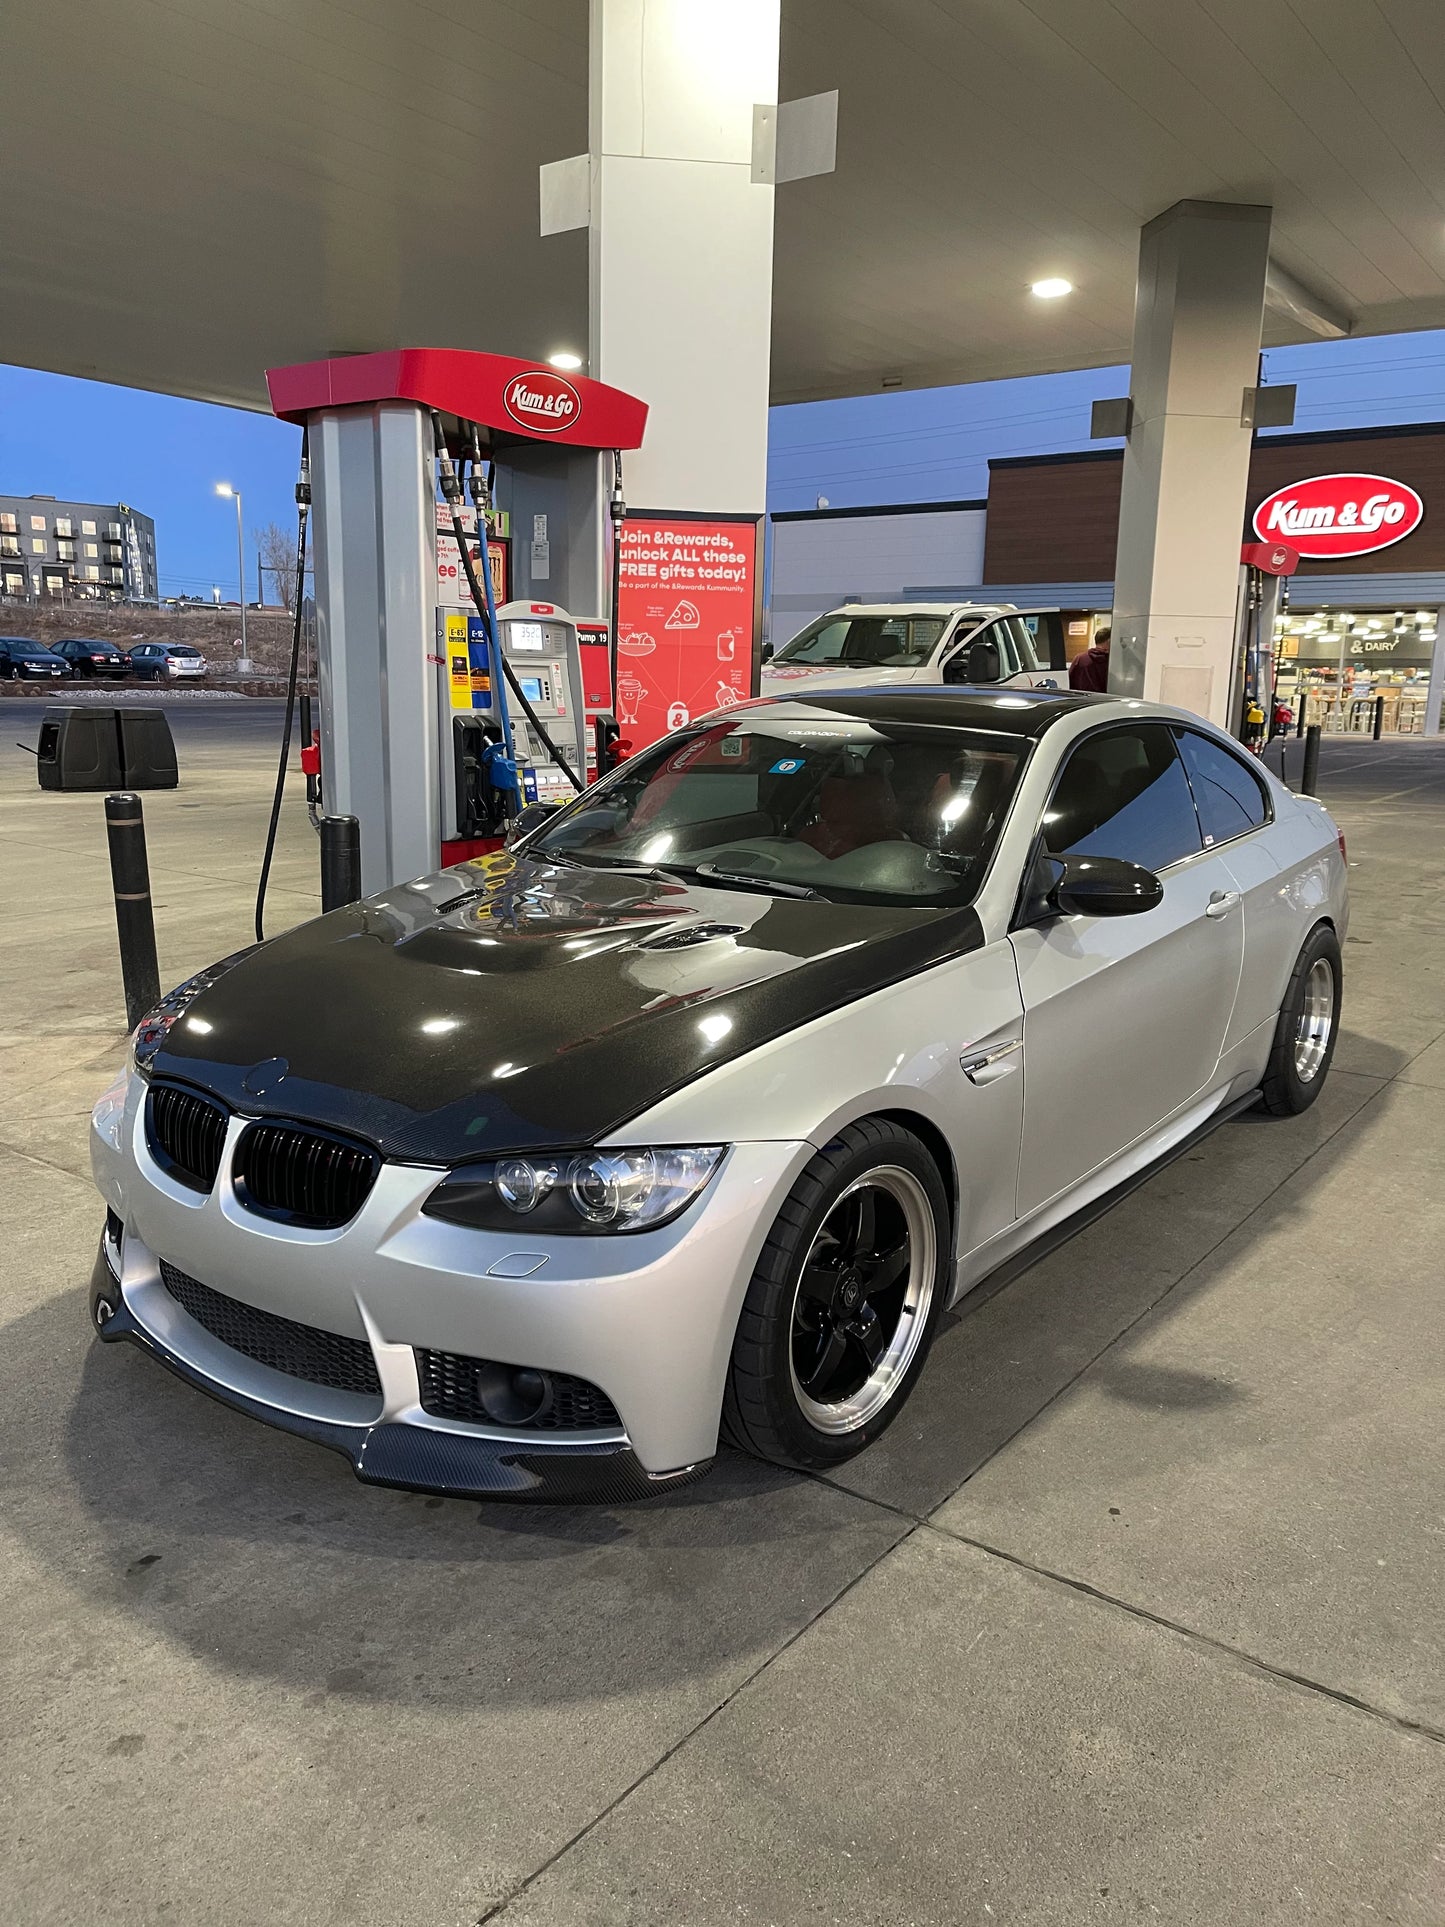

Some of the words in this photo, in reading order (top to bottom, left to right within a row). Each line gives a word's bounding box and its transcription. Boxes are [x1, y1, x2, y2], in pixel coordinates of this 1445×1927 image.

[511, 384, 544, 409] Kum
[544, 394, 554, 410] &
[554, 393, 574, 416] Go
[1266, 500, 1336, 532] Kum
[1337, 502, 1359, 526] &
[1360, 494, 1405, 532] Go
[620, 529, 651, 545] Join
[653, 531, 734, 549] &Rewards,
[619, 546, 669, 561] unlock
[671, 548, 701, 562] ALL
[702, 549, 746, 563] these
[619, 562, 657, 577] FREE
[660, 563, 695, 580] gifts
[697, 565, 746, 583] today!
[634, 582, 650, 590] part
[659, 582, 670, 590] the
[671, 583, 705, 591] &Rewards
[576, 632, 597, 644] Pump
[598, 633, 607, 643] 19
[1350, 640, 1364, 654] &
[1364, 641, 1396, 651] DAIRY
